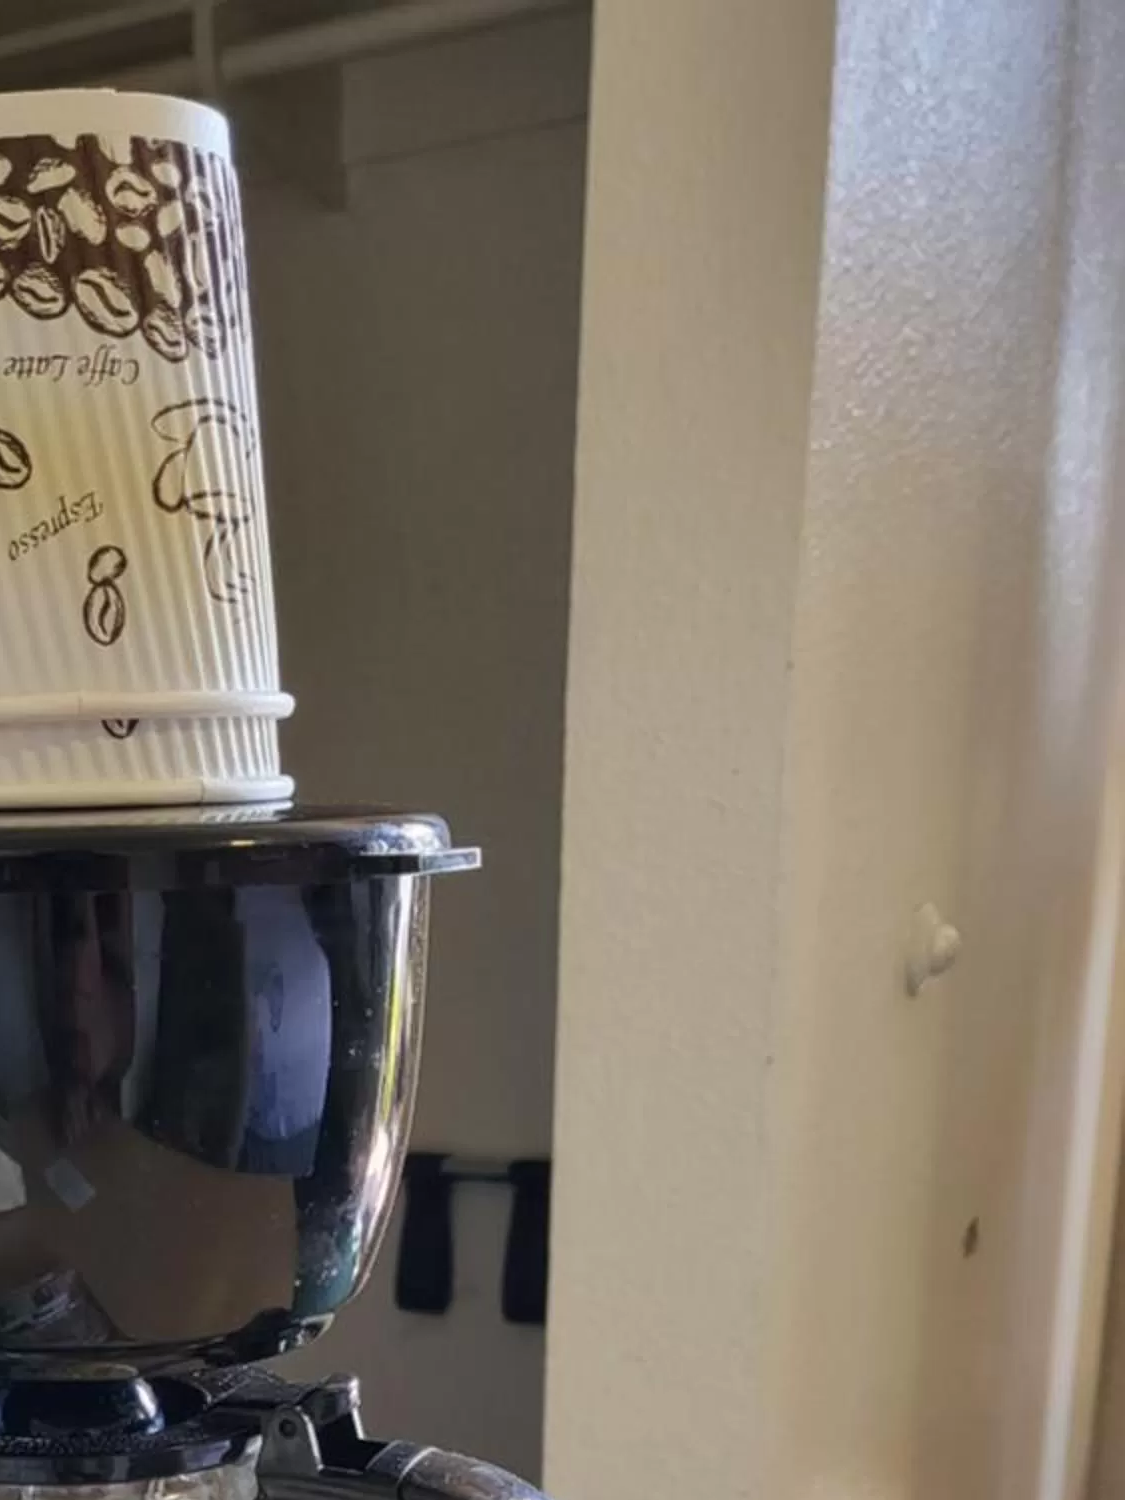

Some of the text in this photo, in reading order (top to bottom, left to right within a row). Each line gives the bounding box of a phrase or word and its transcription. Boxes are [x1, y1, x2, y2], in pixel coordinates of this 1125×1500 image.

[3, 344, 140, 385] Caffe Latte
[7, 491, 104, 562] Espresso
